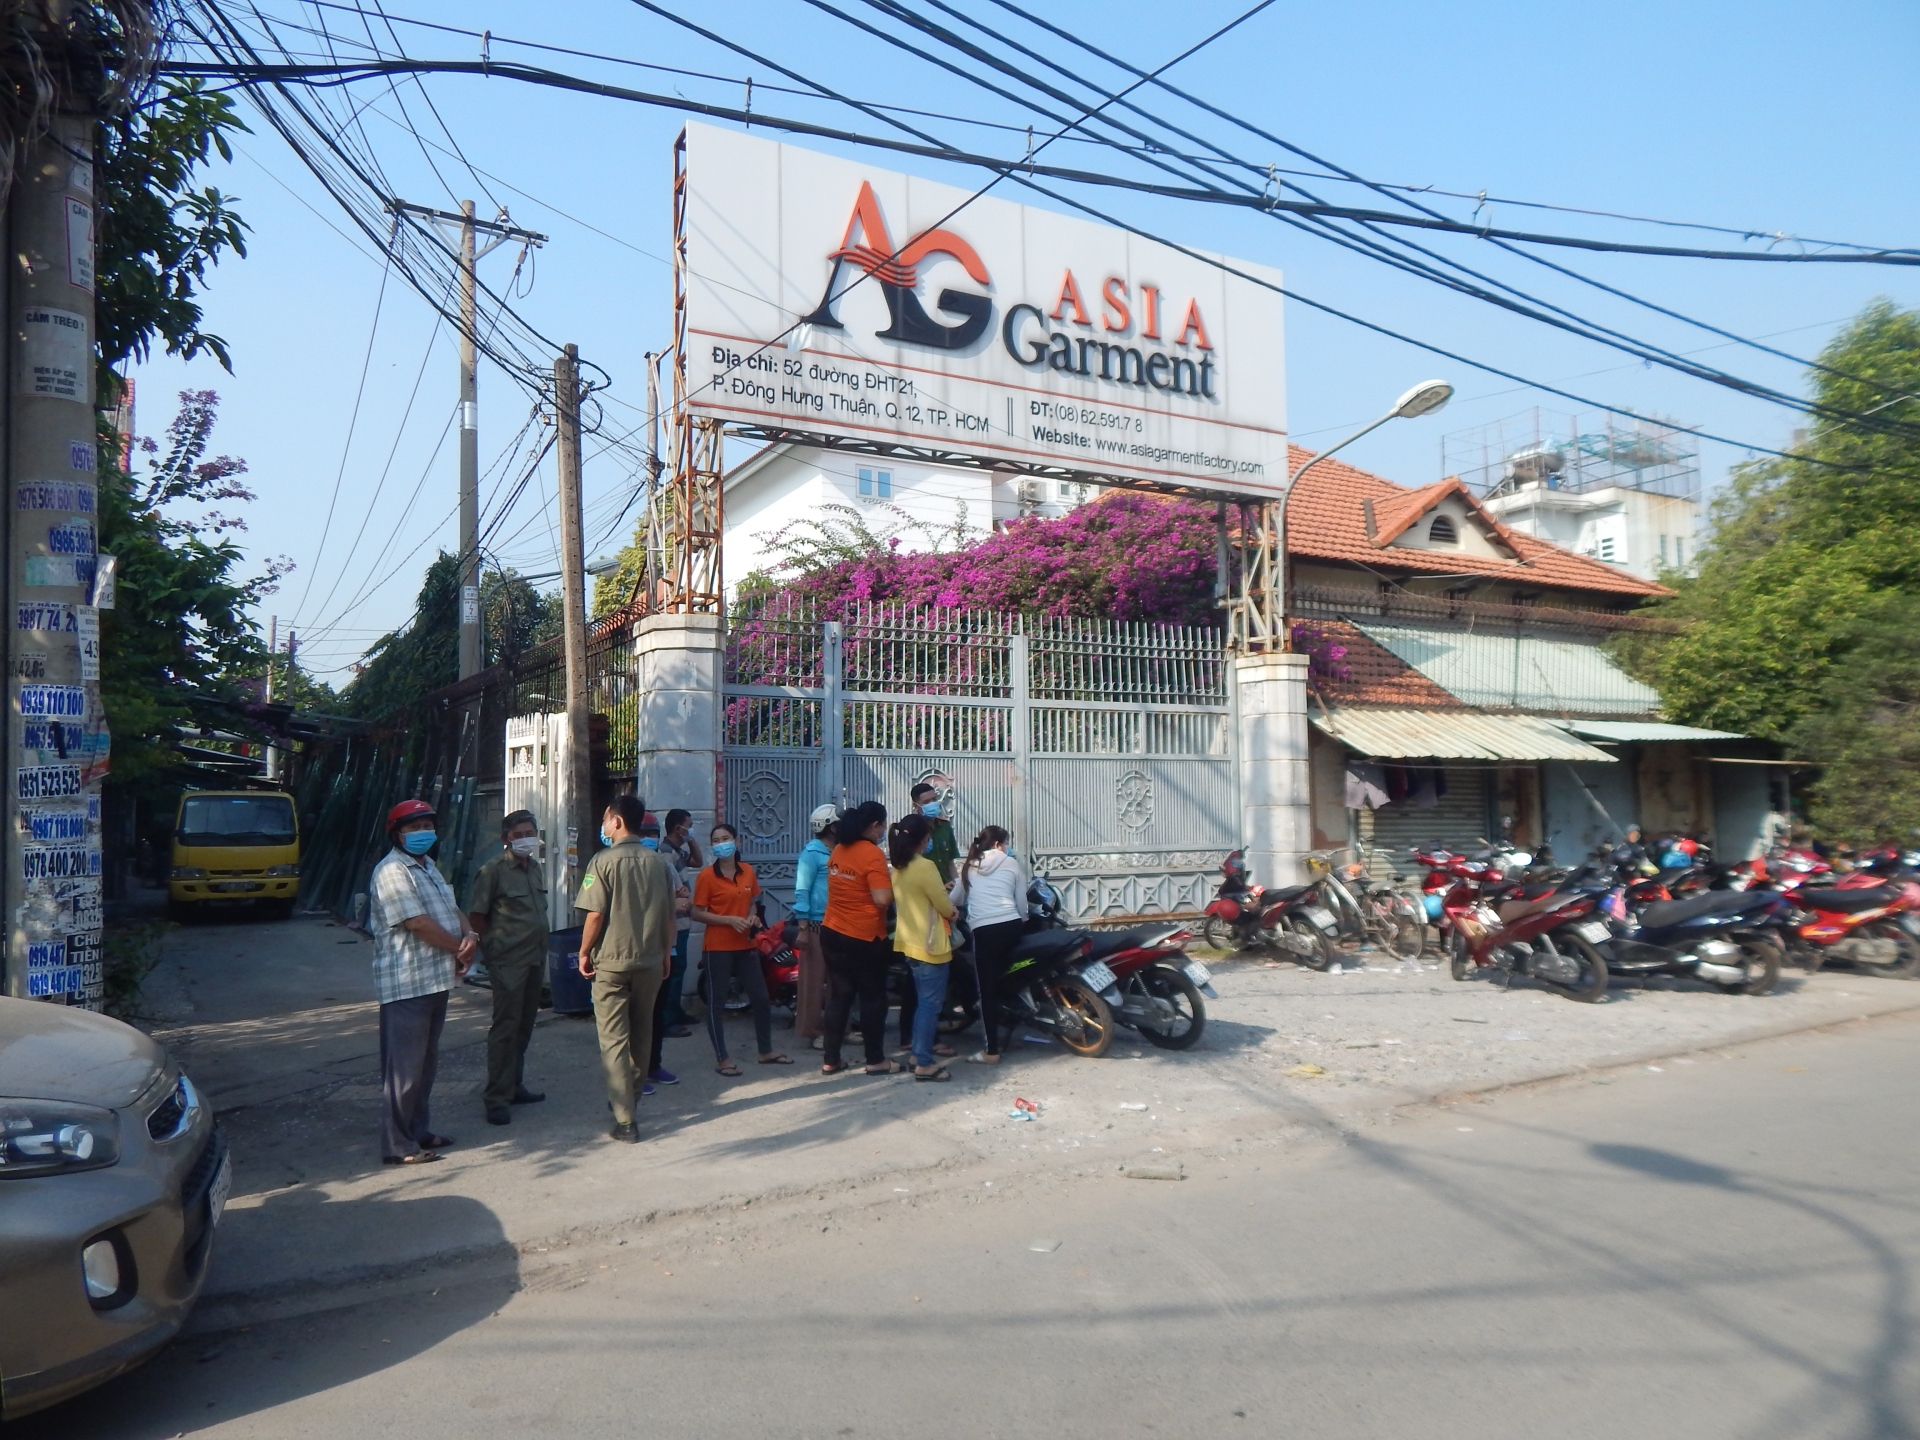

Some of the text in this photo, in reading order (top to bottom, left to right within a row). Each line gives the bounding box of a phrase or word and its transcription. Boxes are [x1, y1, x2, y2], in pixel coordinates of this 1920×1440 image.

[800, 180, 993, 349] AG
[1050, 268, 1214, 350] ASIA
[712, 346, 917, 399] Địa chỉ: 52 đường ĐHT21,
[1002, 303, 1217, 398] Garment
[713, 374, 989, 433] P. Đông Hưng Thuận, Q. 12, TP. HCM
[1031, 401, 1053, 418] ĐT:
[1032, 424, 1265, 476] Website: www.asiagarmentfactory.com
[21, 690, 84, 716] 0939.110.100
[18, 770, 81, 798] 0931.523.525
[24, 850, 87, 878] 0978.400.200
